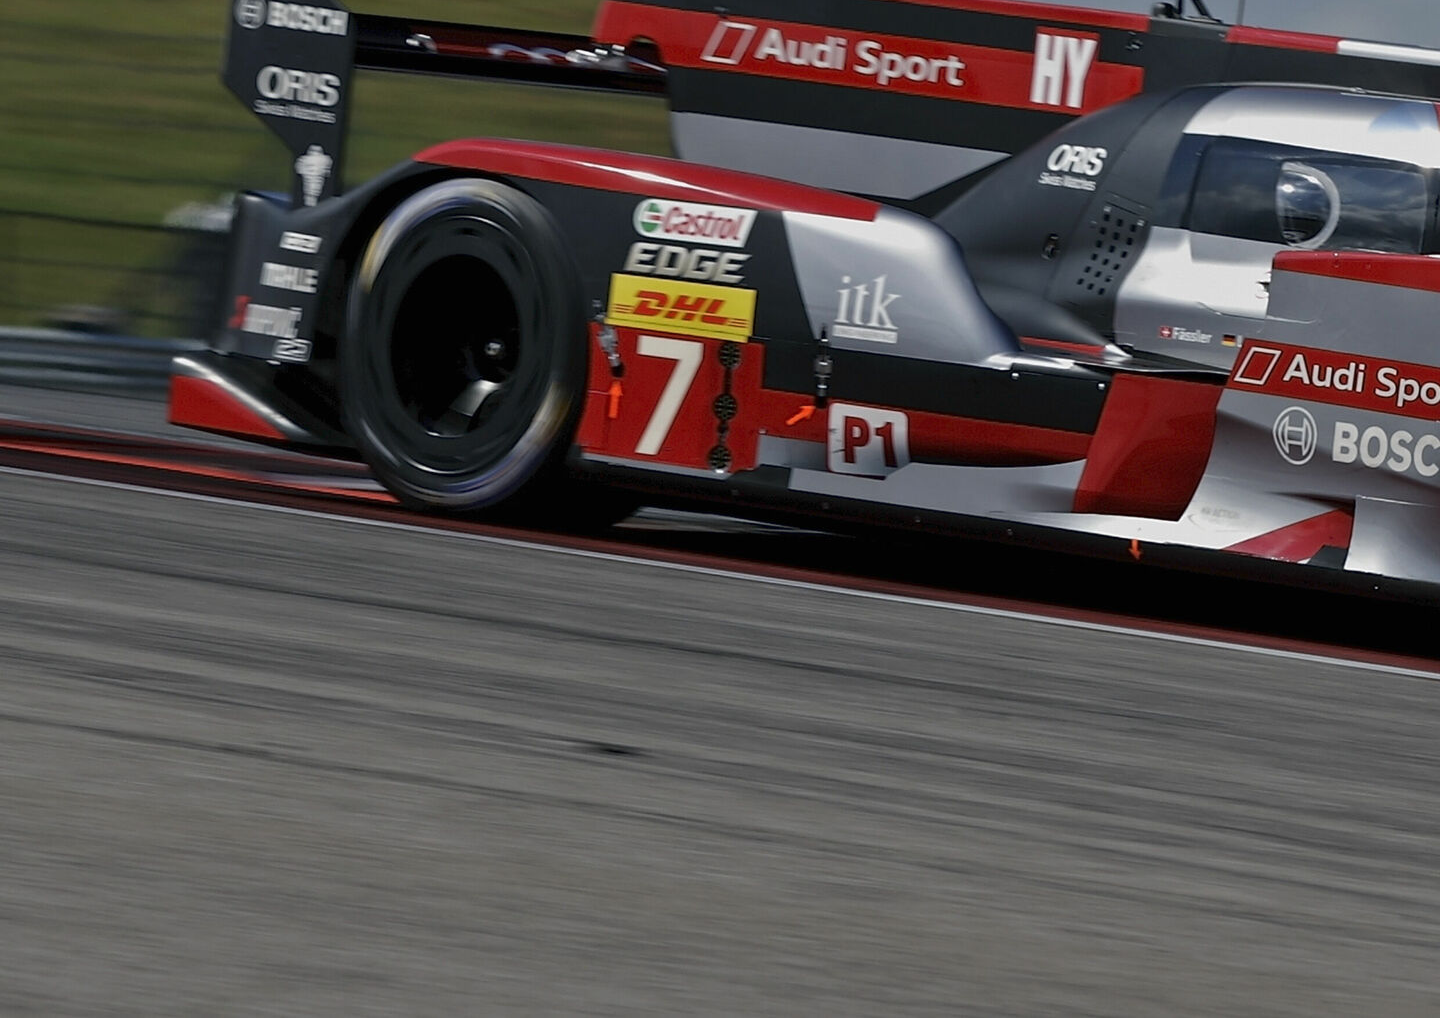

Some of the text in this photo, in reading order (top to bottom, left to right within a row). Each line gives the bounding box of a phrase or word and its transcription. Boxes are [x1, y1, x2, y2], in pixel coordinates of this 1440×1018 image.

[266, 0, 349, 36] BOSCH
[754, 28, 965, 86] Audi Sport
[1029, 33, 1098, 109] HY
[256, 65, 341, 107] ORIS
[1047, 144, 1108, 176] ORIS
[663, 206, 745, 241] Castrol
[623, 242, 752, 284] EDGE
[632, 290, 728, 326] DHL
[834, 274, 903, 330] itk
[1283, 354, 1366, 393] Audi
[635, 335, 704, 456] 7
[843, 416, 898, 468] P1
